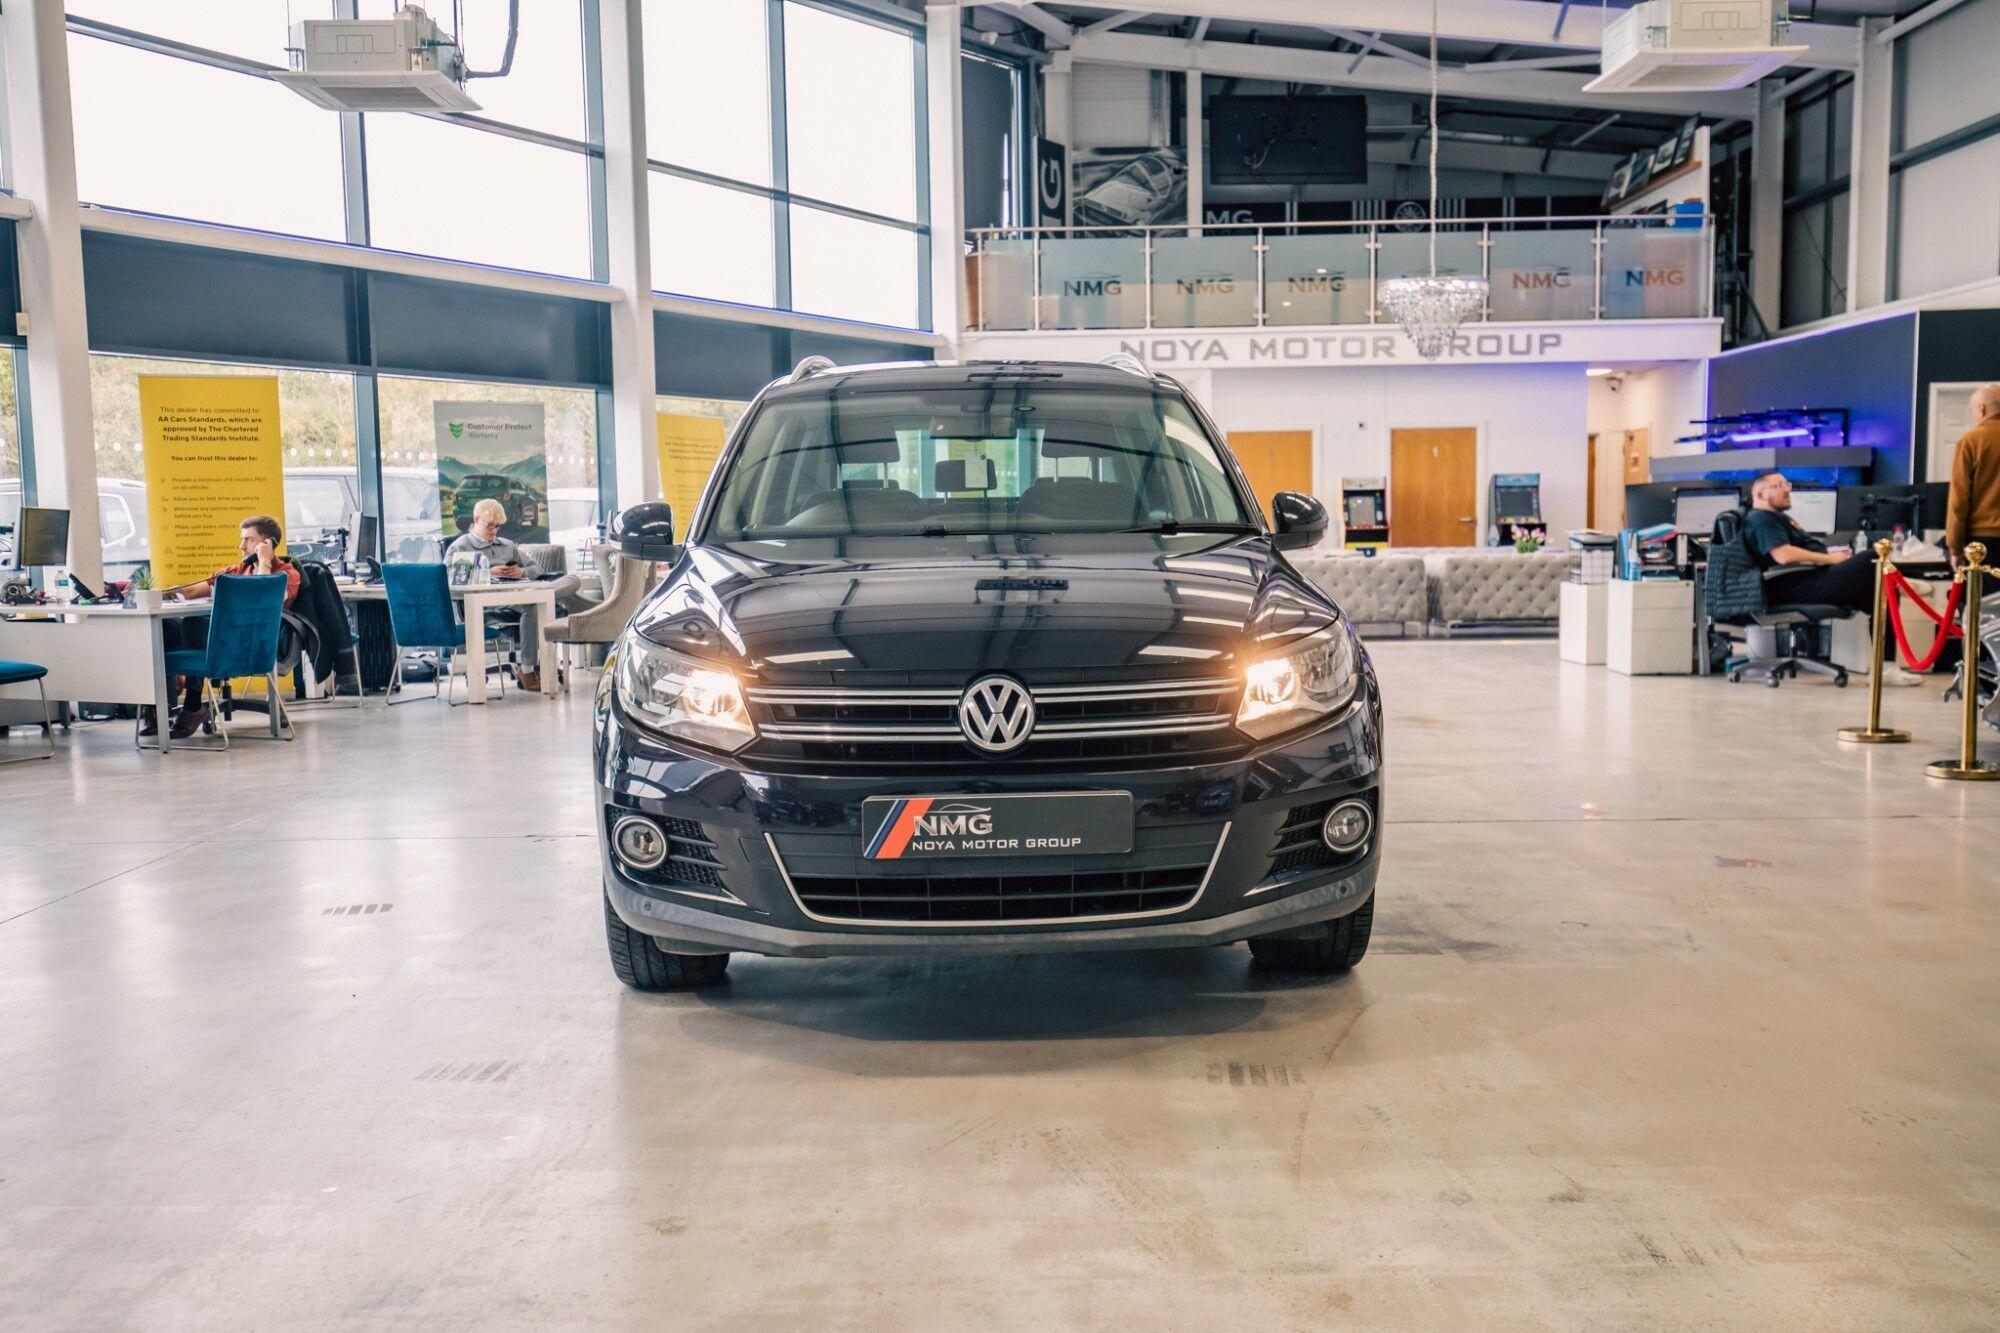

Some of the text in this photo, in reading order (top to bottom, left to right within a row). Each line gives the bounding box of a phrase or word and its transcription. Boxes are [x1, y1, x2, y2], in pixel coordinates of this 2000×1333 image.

[1176, 278, 1234, 295] NMG
[1288, 276, 1346, 293] NMG
[1626, 270, 1685, 286] NMG
[1064, 280, 1122, 296] NMG
[1120, 339, 1229, 362] NOYA
[1250, 336, 1397, 360] MOTOR
[913, 814, 993, 836] NMG
[912, 838, 1082, 851] NOYA MOTOR GROUP
